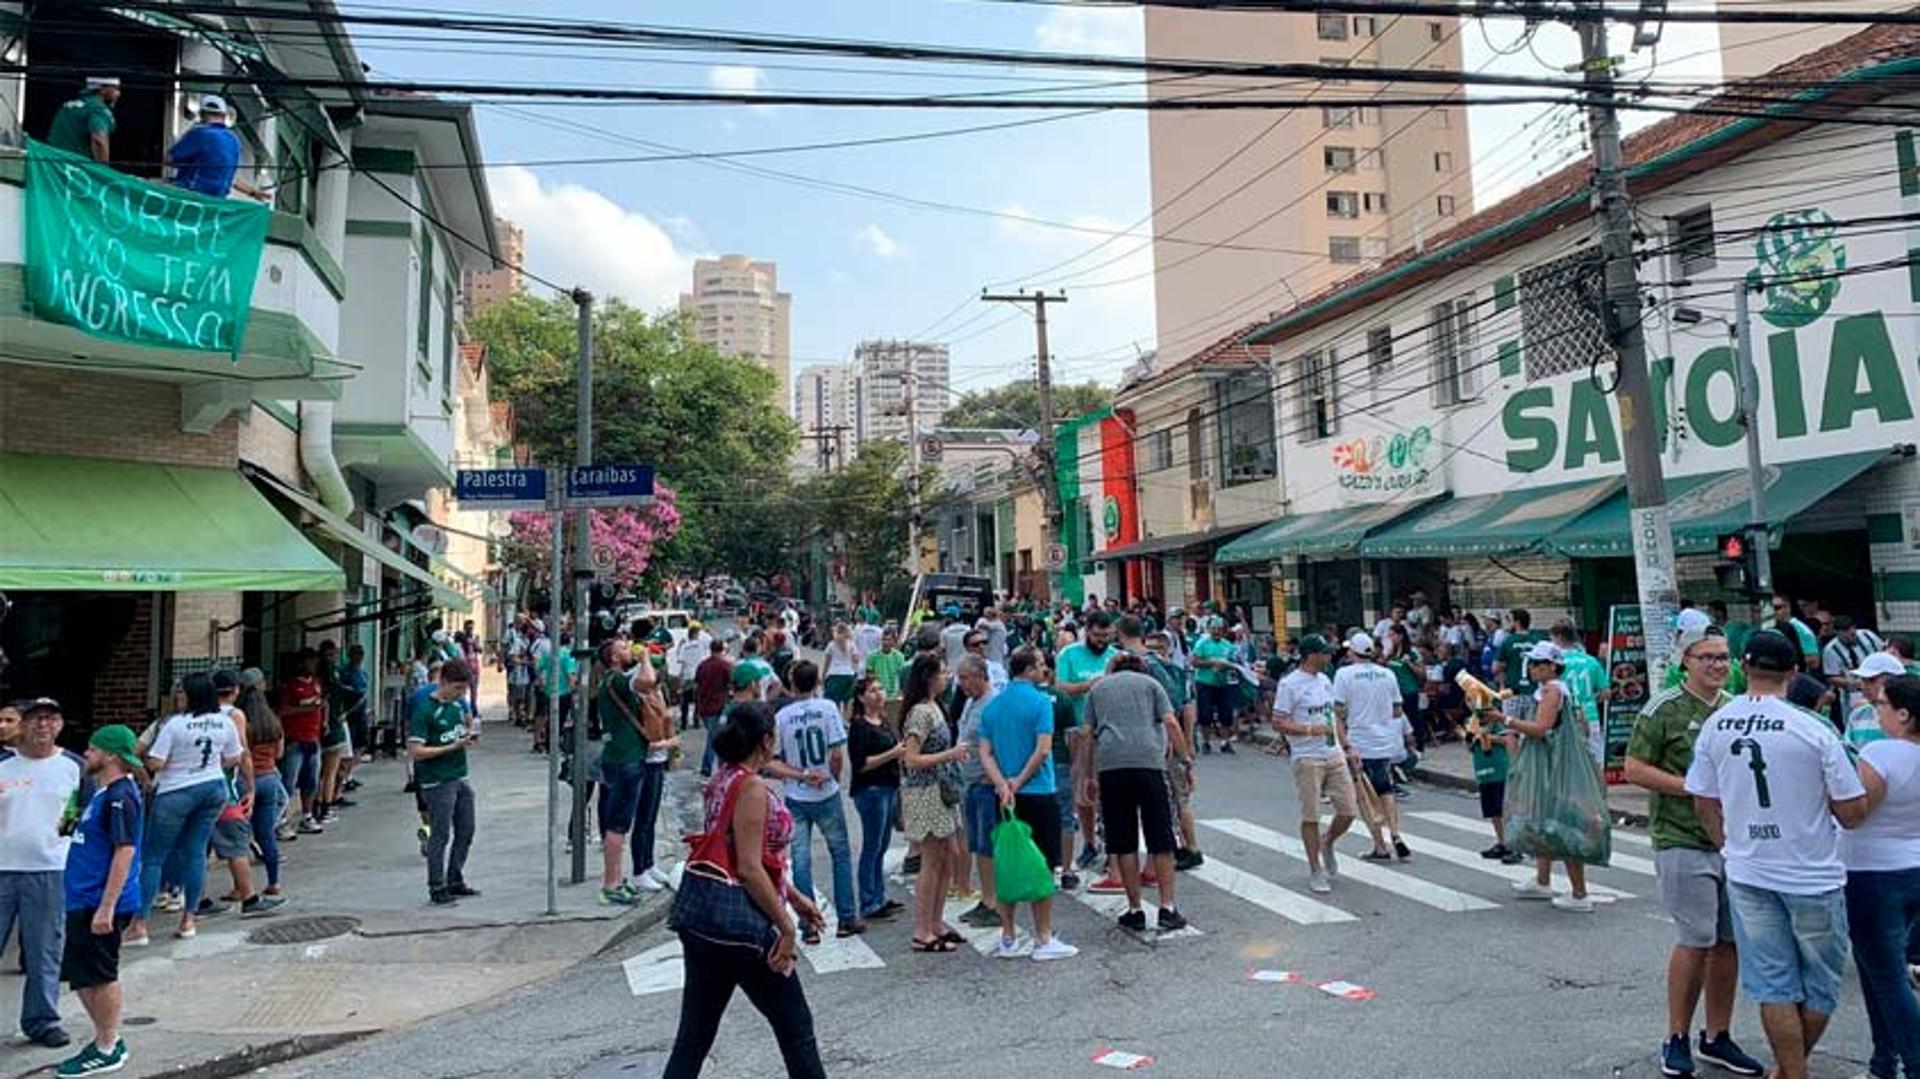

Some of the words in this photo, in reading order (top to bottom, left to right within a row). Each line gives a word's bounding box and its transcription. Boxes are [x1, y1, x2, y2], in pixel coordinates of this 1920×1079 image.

[156, 253, 231, 304] TEM
[53, 265, 222, 349] INGRESSO
[463, 472, 526, 487] Palestra
[1566, 669, 1593, 706] 11
[1717, 715, 1785, 736] crefisa
[795, 726, 825, 767] 10
[1731, 738, 1771, 808] 7
